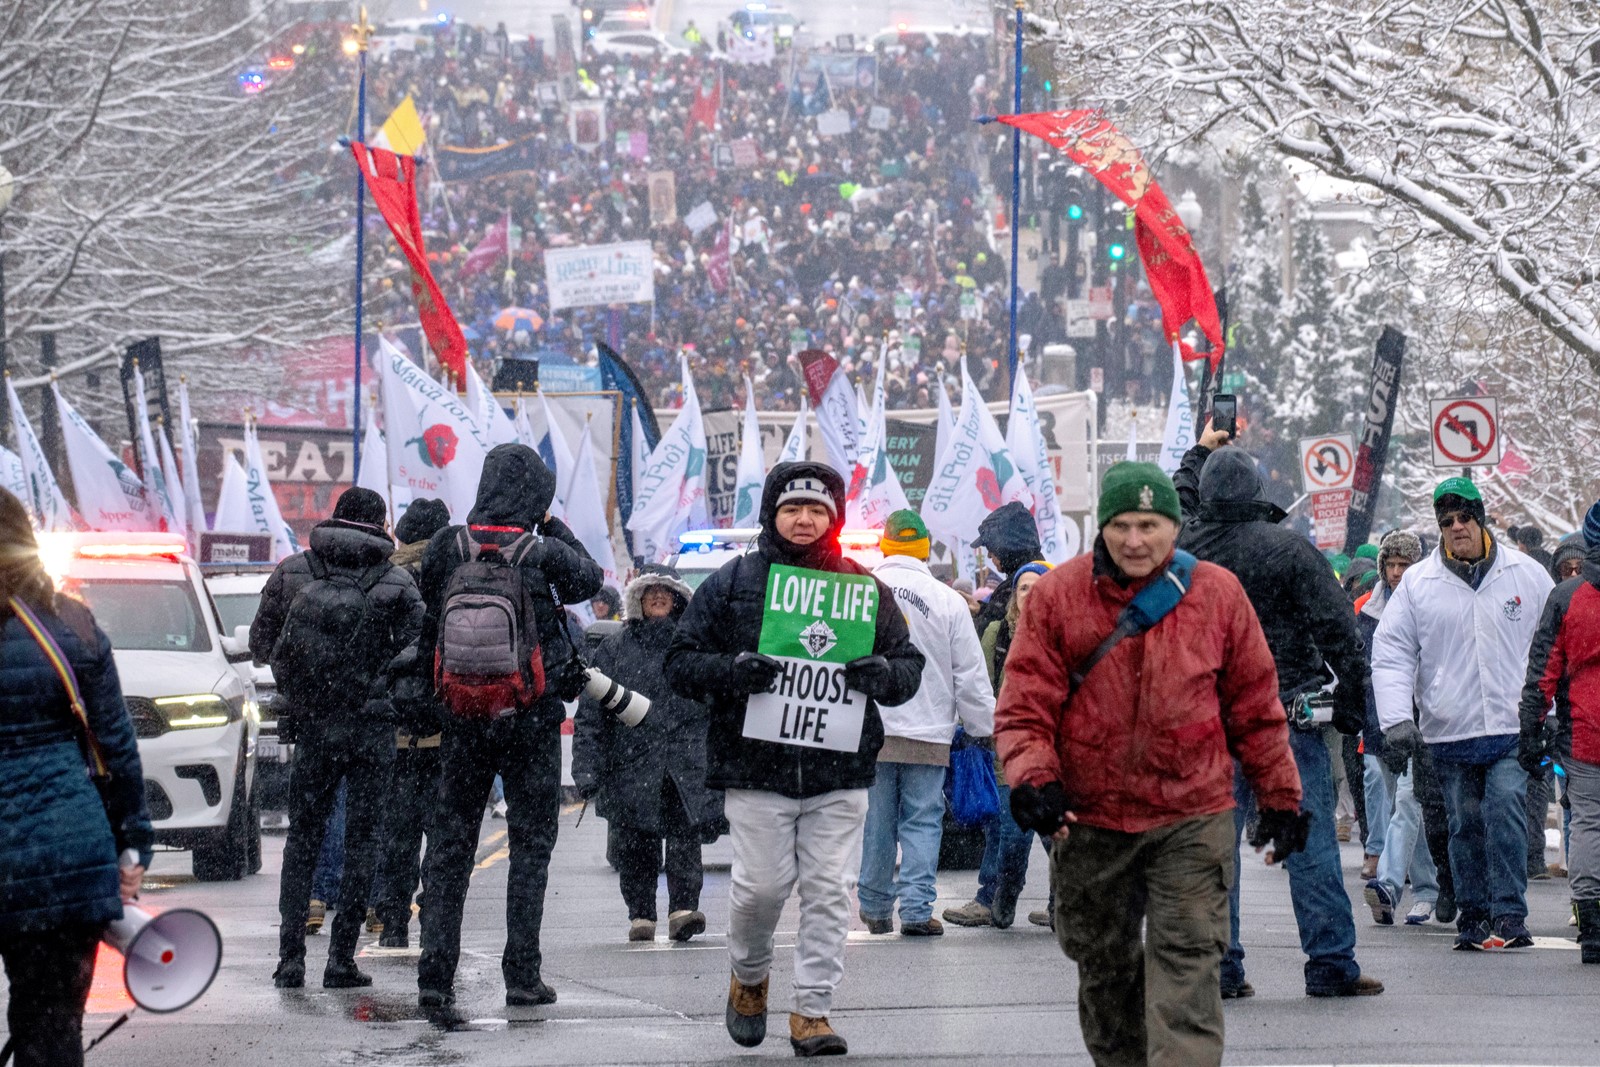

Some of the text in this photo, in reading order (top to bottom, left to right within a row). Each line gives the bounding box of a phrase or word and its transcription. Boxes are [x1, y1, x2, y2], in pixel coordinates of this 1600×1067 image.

[603, 256, 644, 276] LIFE
[391, 354, 442, 401] March
[706, 432, 736, 455] LIFE
[886, 436, 919, 449] ERY
[217, 438, 363, 482] DEAT
[707, 455, 738, 494] IS
[888, 454, 921, 466] MAN
[247, 468, 270, 533] Mar
[1319, 492, 1345, 504] SNOW
[213, 546, 246, 558] make
[548, 583, 561, 606] SONY
[770, 573, 876, 622] LOVE LIFE
[898, 587, 930, 620] COLUMBUS
[767, 662, 854, 705] HOOS
[779, 703, 829, 743] LIFE
